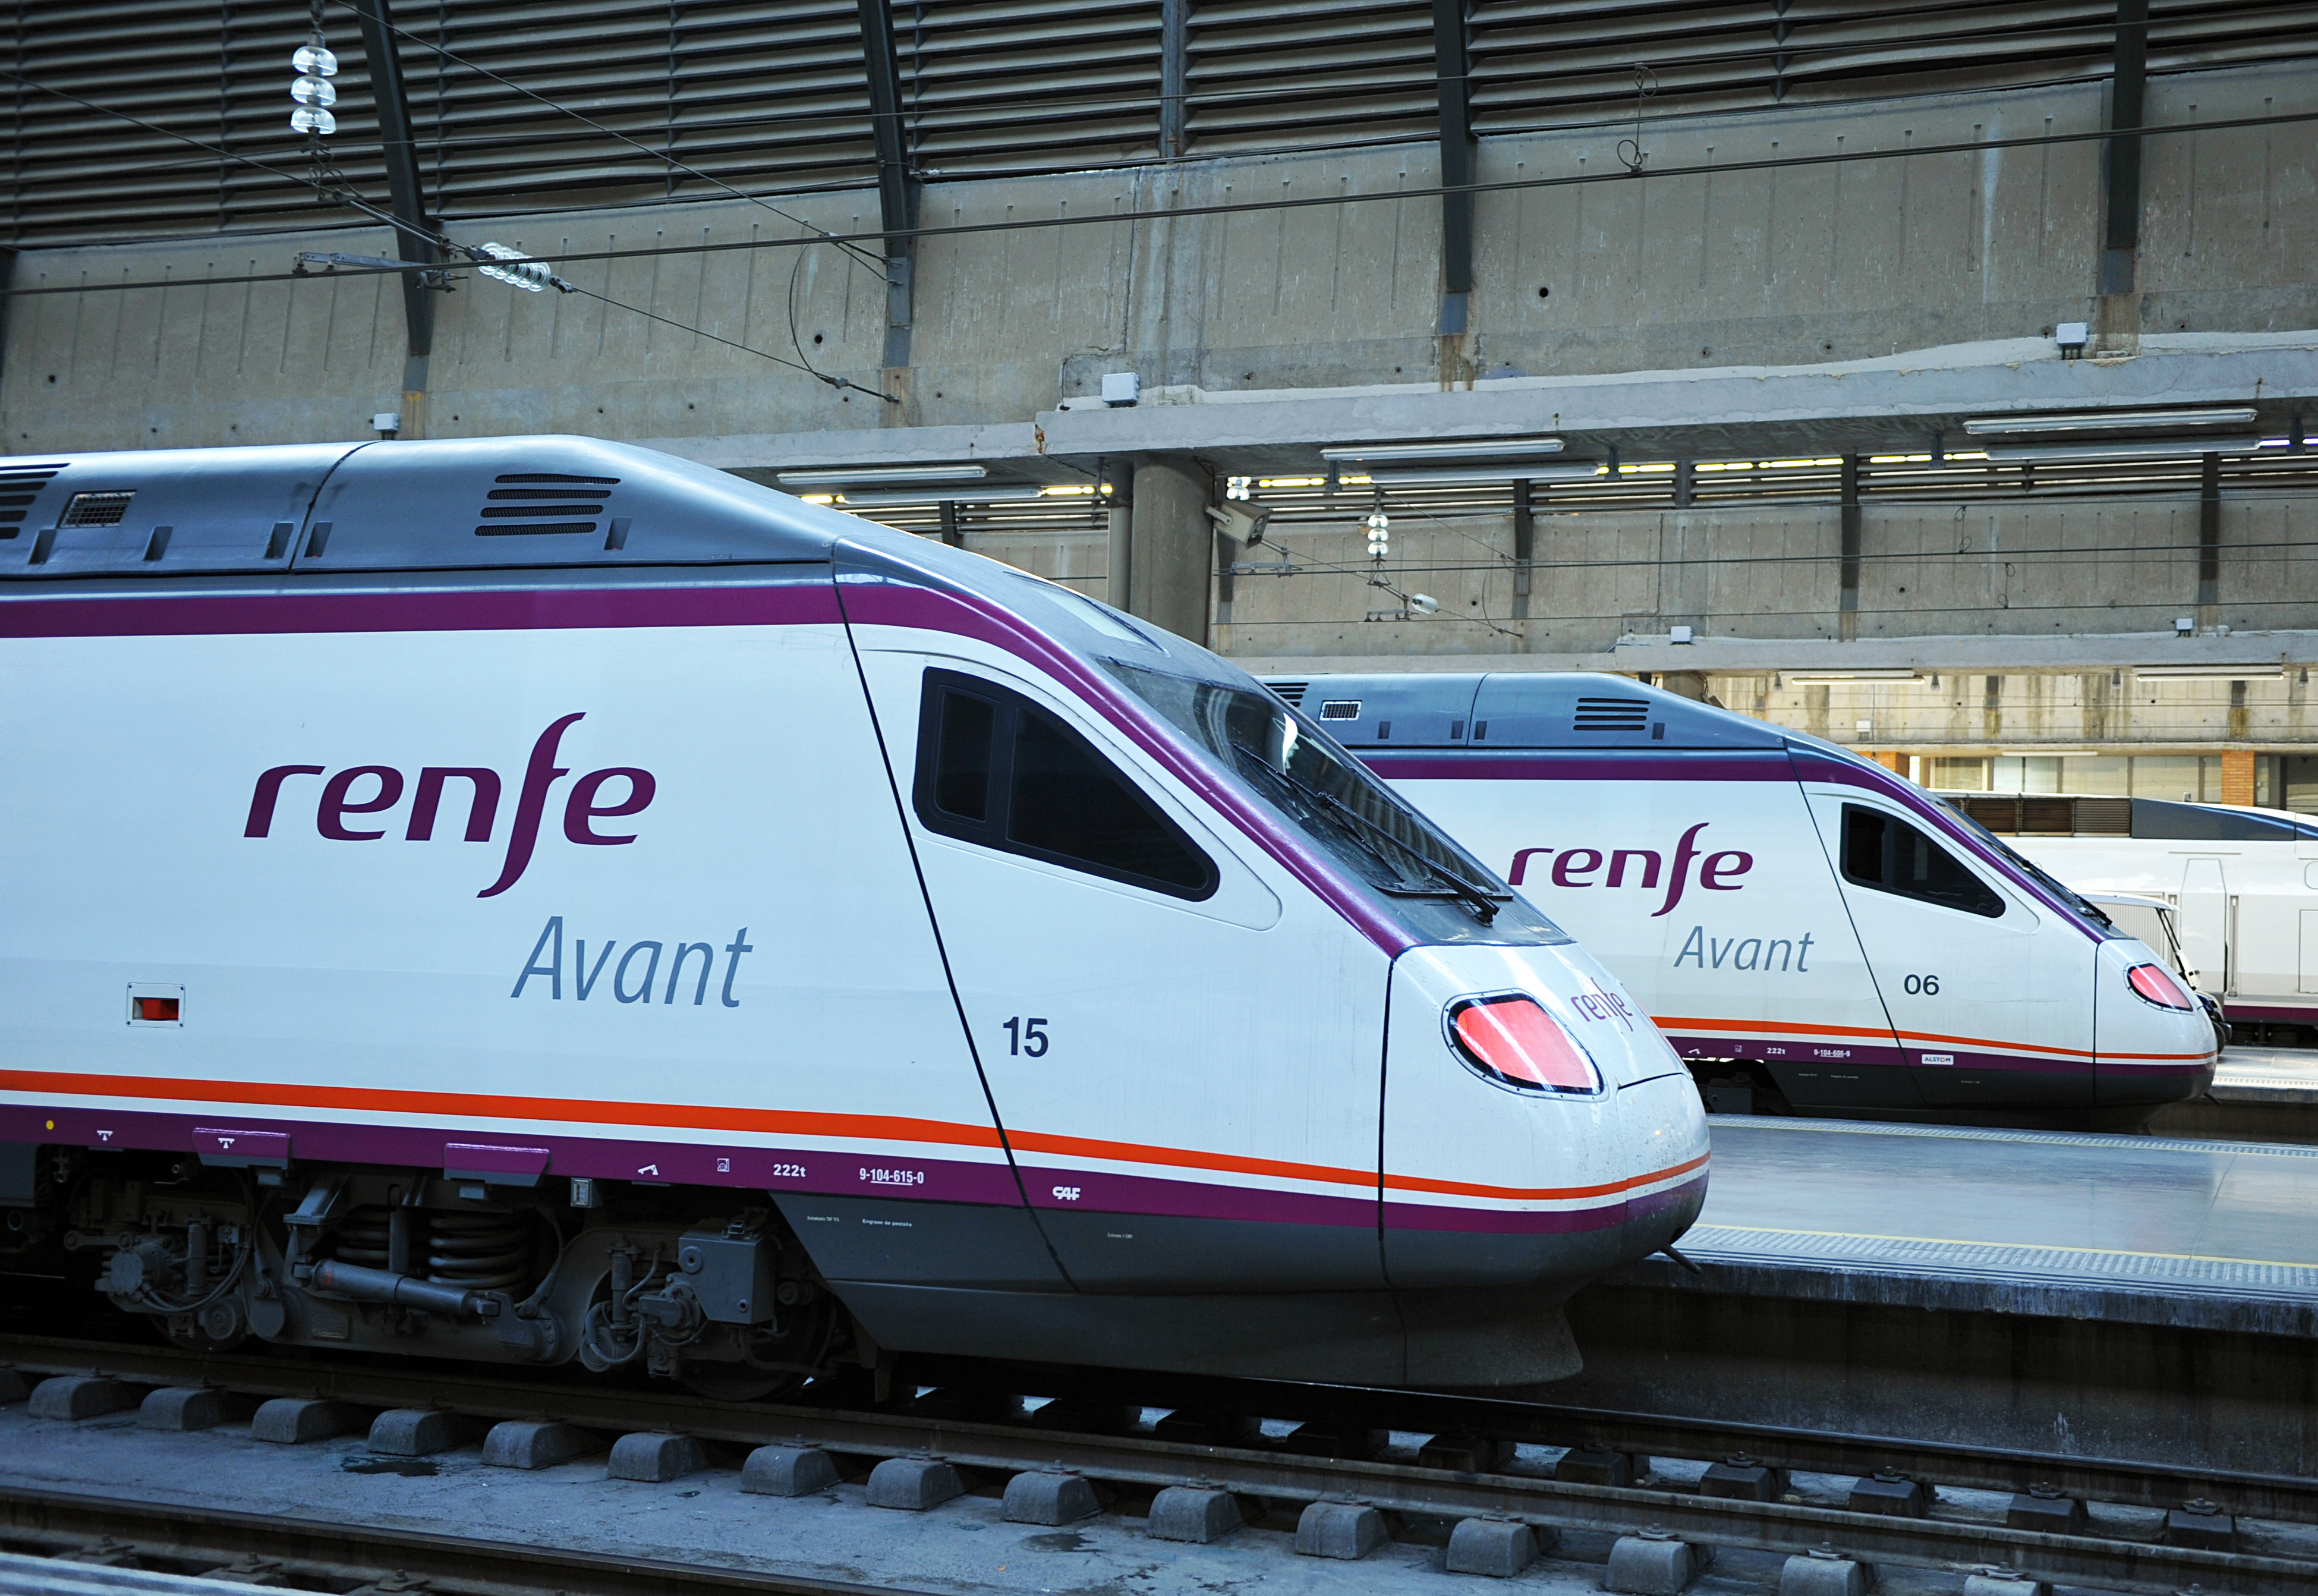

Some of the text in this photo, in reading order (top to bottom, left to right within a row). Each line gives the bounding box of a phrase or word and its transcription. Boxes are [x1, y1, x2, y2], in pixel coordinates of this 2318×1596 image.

[243, 712, 657, 899] renfe
[1508, 822, 1753, 917] renfe
[510, 915, 754, 1008] Avant
[1673, 926, 1815, 972] Avant
[1570, 977, 1633, 1032] renfe
[1904, 974, 1939, 996] 06
[1003, 1016, 1048, 1057] 15
[773, 1164, 806, 1178] 222t
[859, 1167, 924, 1185] 9-104-615-0
[1052, 1186, 1081, 1201] CAF
